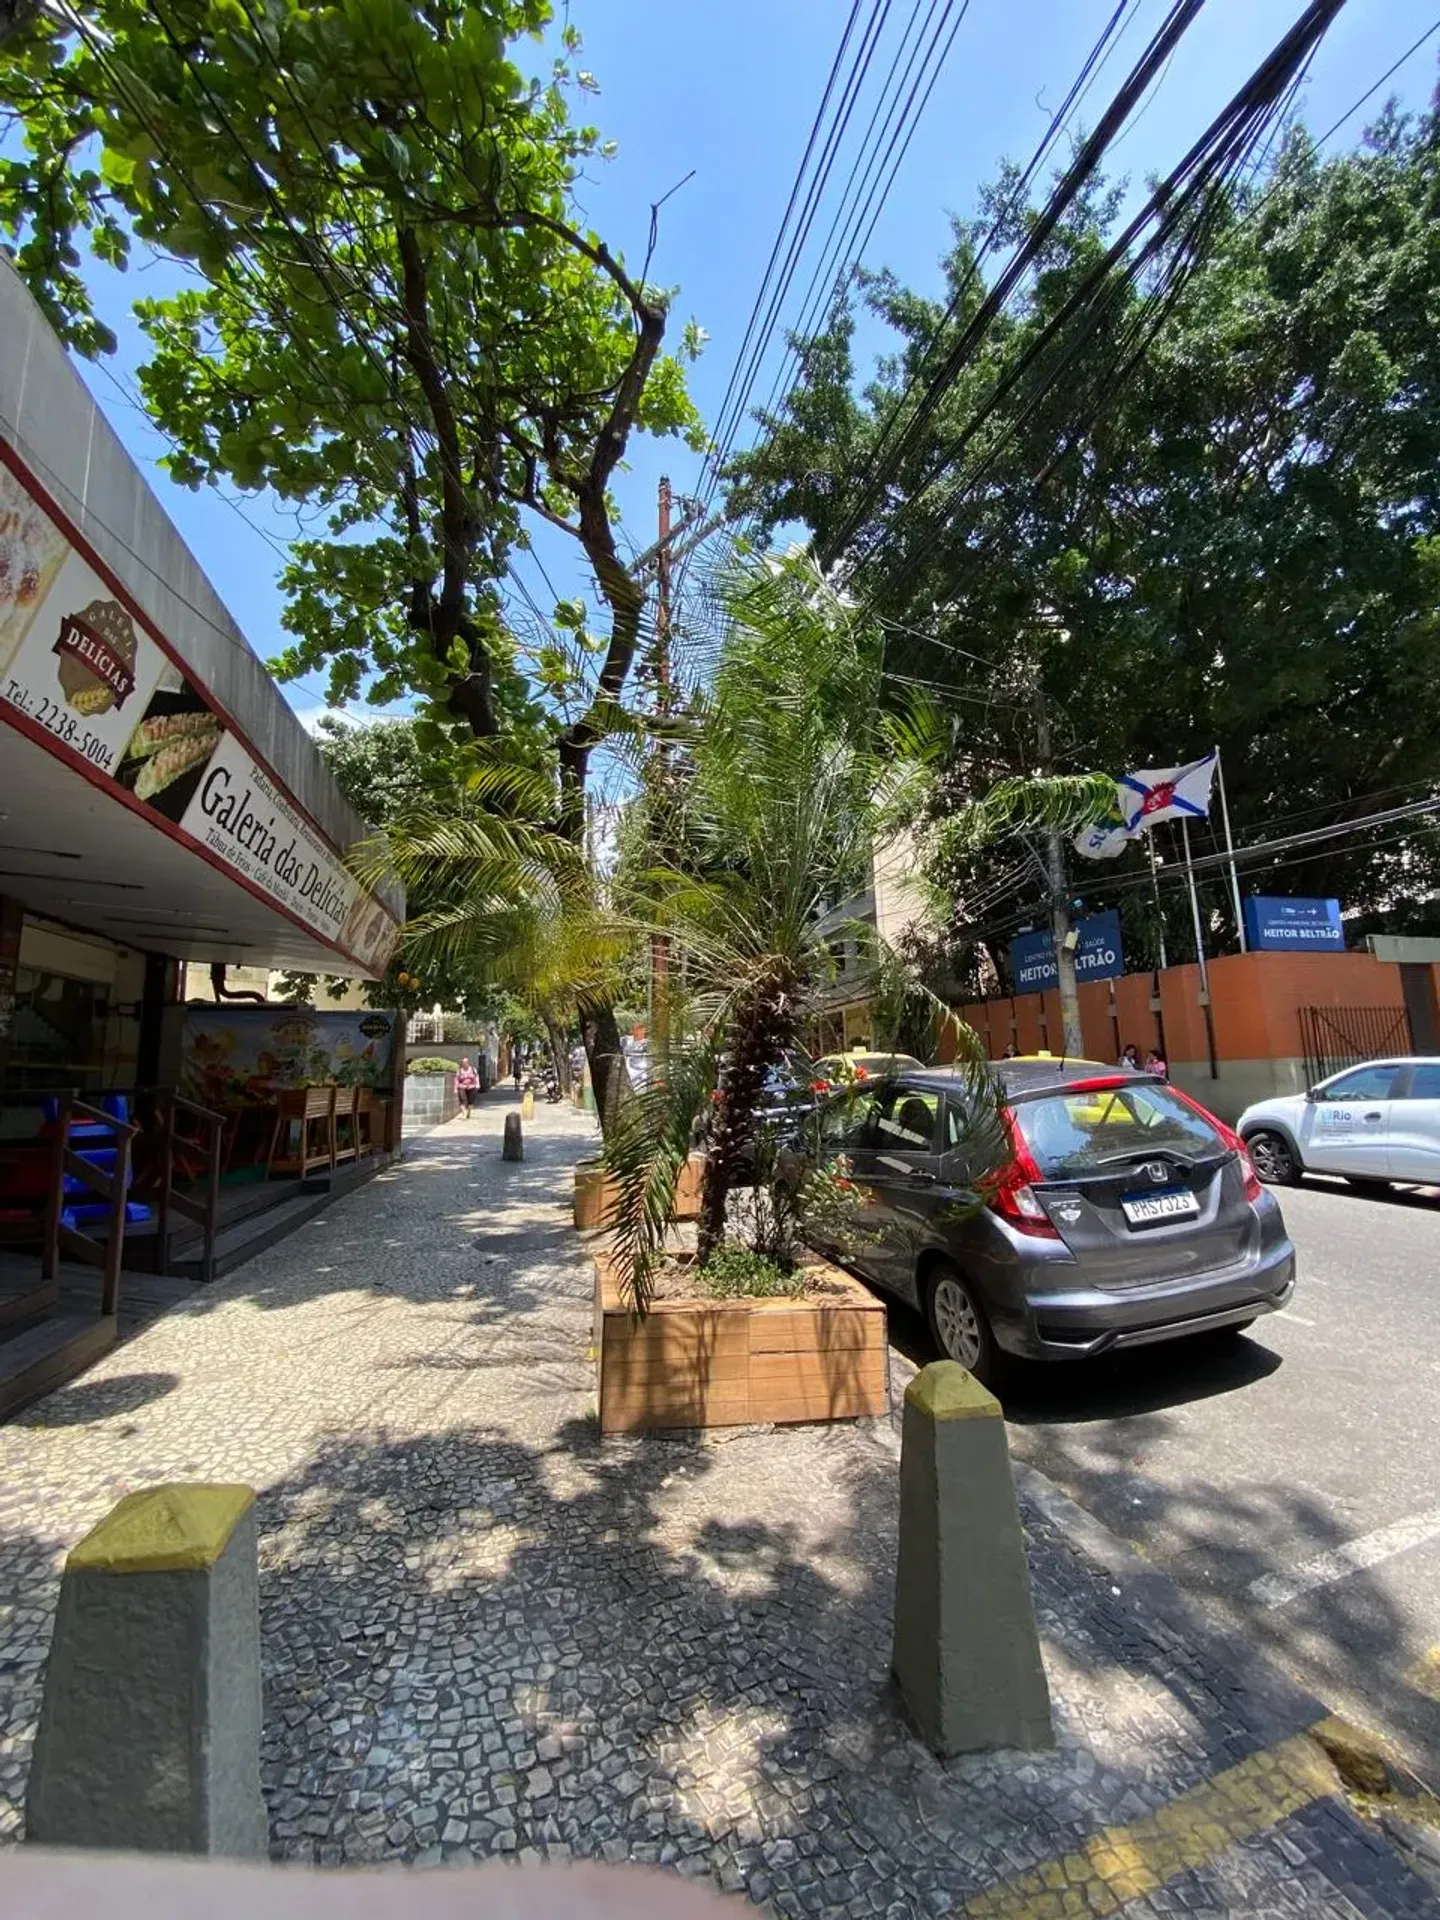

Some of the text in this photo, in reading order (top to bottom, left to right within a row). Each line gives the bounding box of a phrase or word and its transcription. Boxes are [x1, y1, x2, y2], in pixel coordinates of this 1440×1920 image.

[88, 608, 132, 659] GALERIA
[66, 627, 129, 694] DELÍCIAS
[5, 680, 115, 770] Tel.: 2238-5004
[201, 767, 277, 866] Galeria
[274, 838, 303, 888] das
[298, 862, 349, 926] Delícias
[1264, 927, 1340, 939] HEITOR BELTRÃO
[1074, 948, 1116, 971] LTRÃO
[1333, 1110, 1352, 1121] Rio
